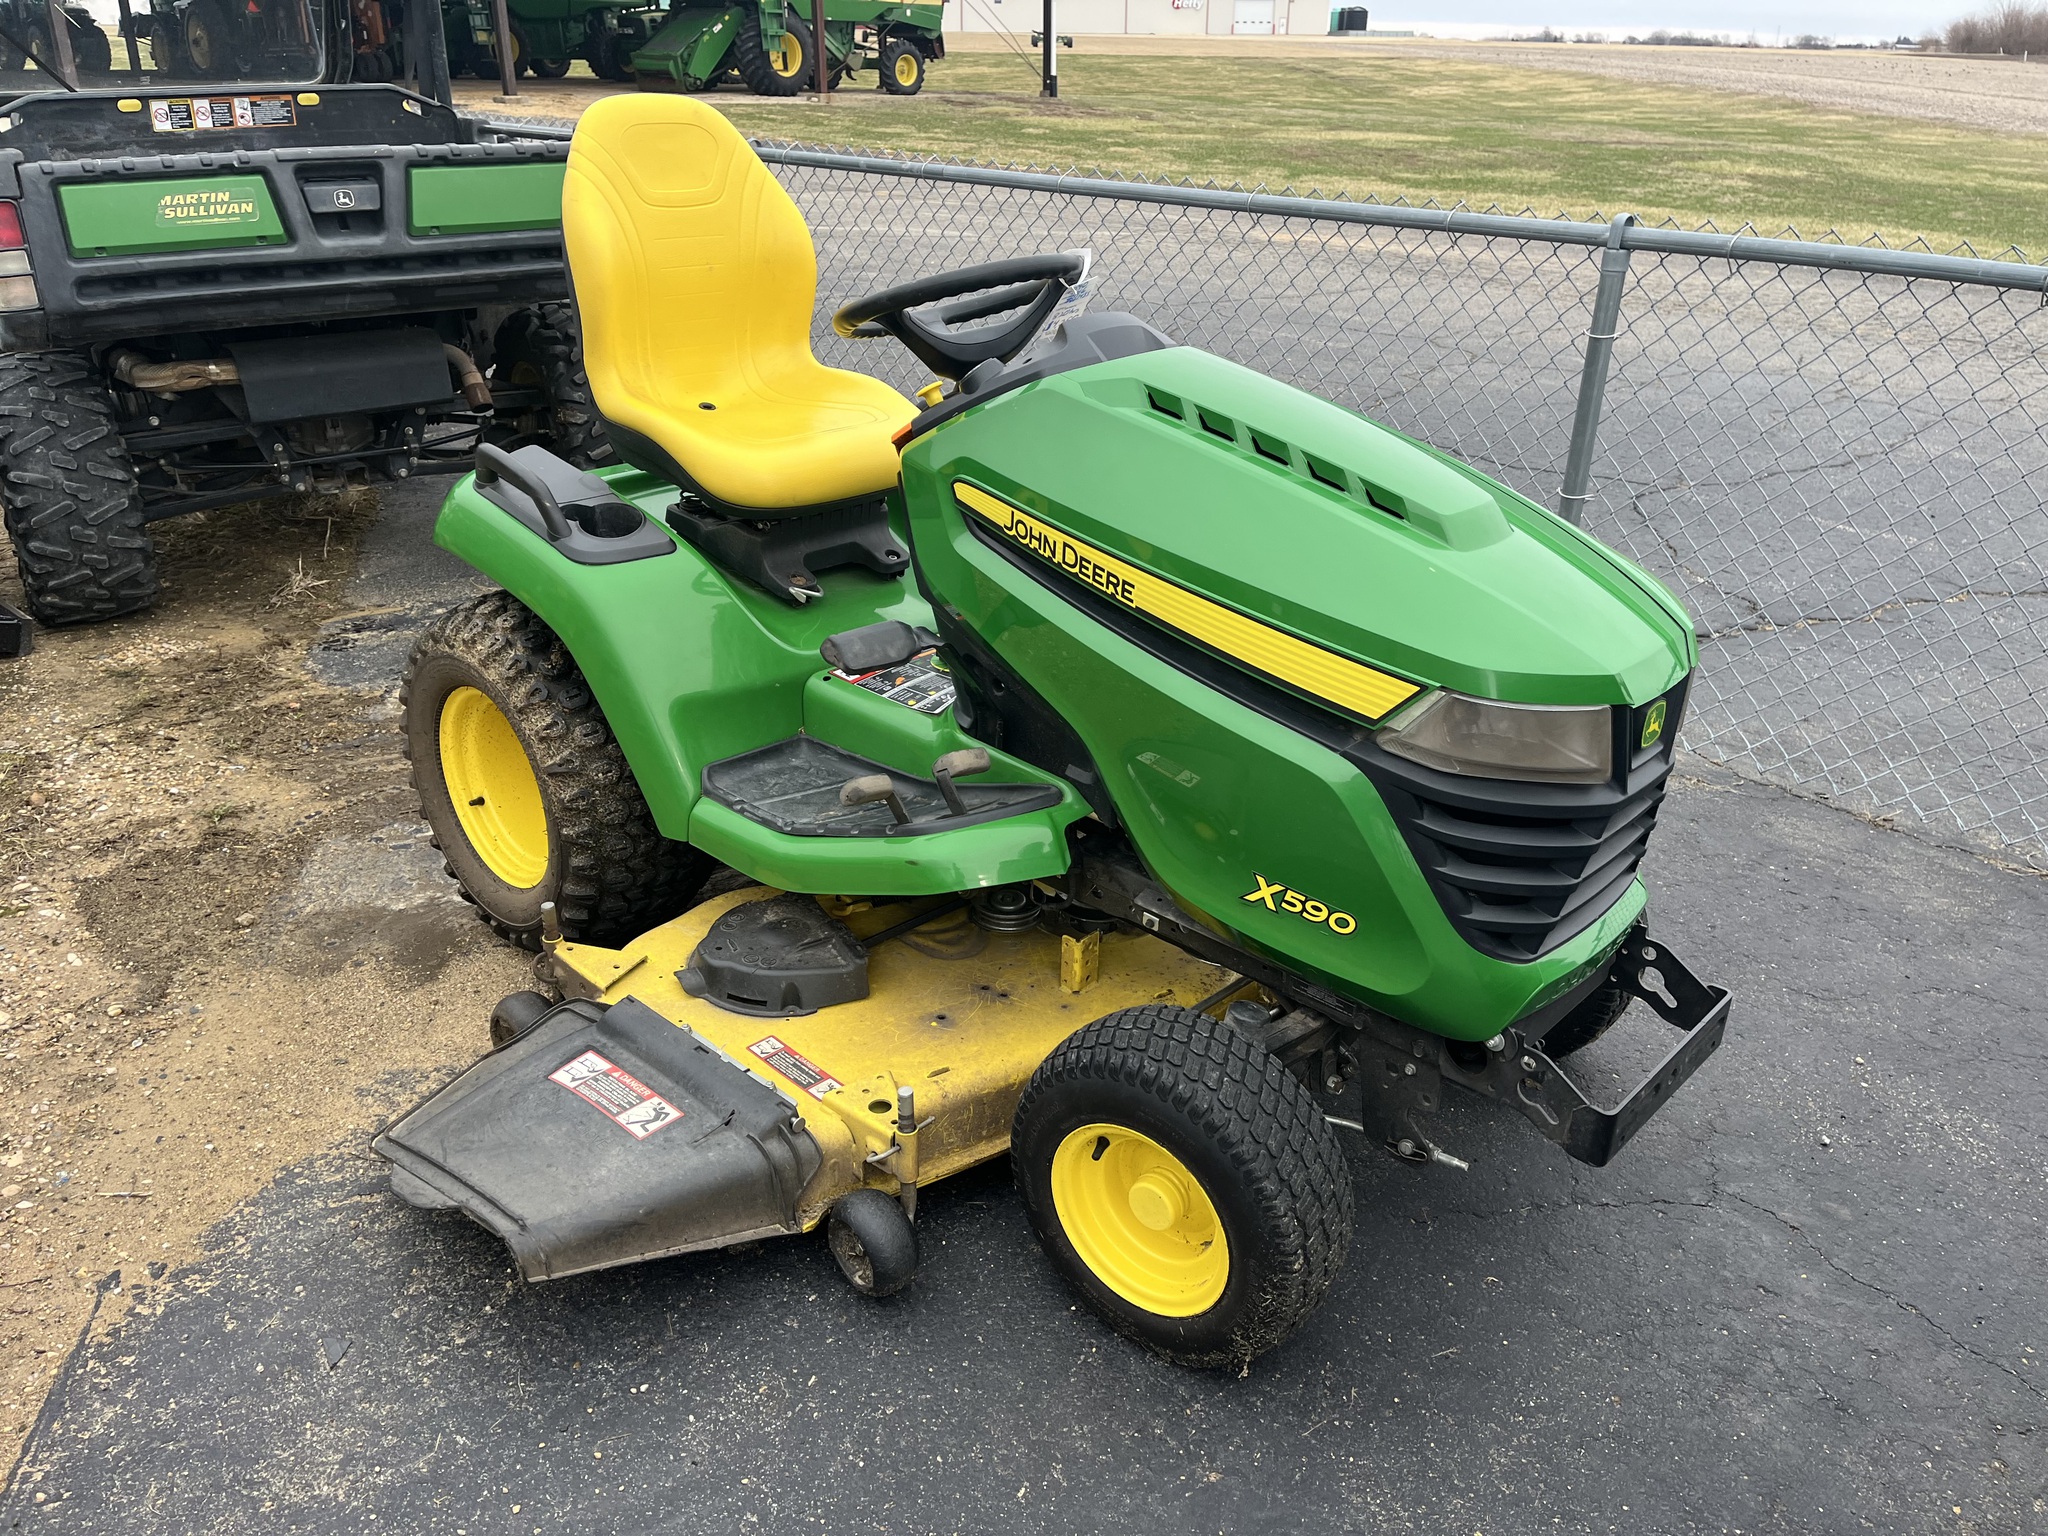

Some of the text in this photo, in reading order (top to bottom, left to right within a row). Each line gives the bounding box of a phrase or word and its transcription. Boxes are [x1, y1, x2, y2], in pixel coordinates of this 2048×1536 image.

[158, 192, 230, 207] MARTIN
[164, 202, 253, 219] SULLIVAN
[1003, 510, 1137, 607] JOHN DEERE
[1240, 870, 1358, 936] X590
[619, 1074, 652, 1097] DANGER
